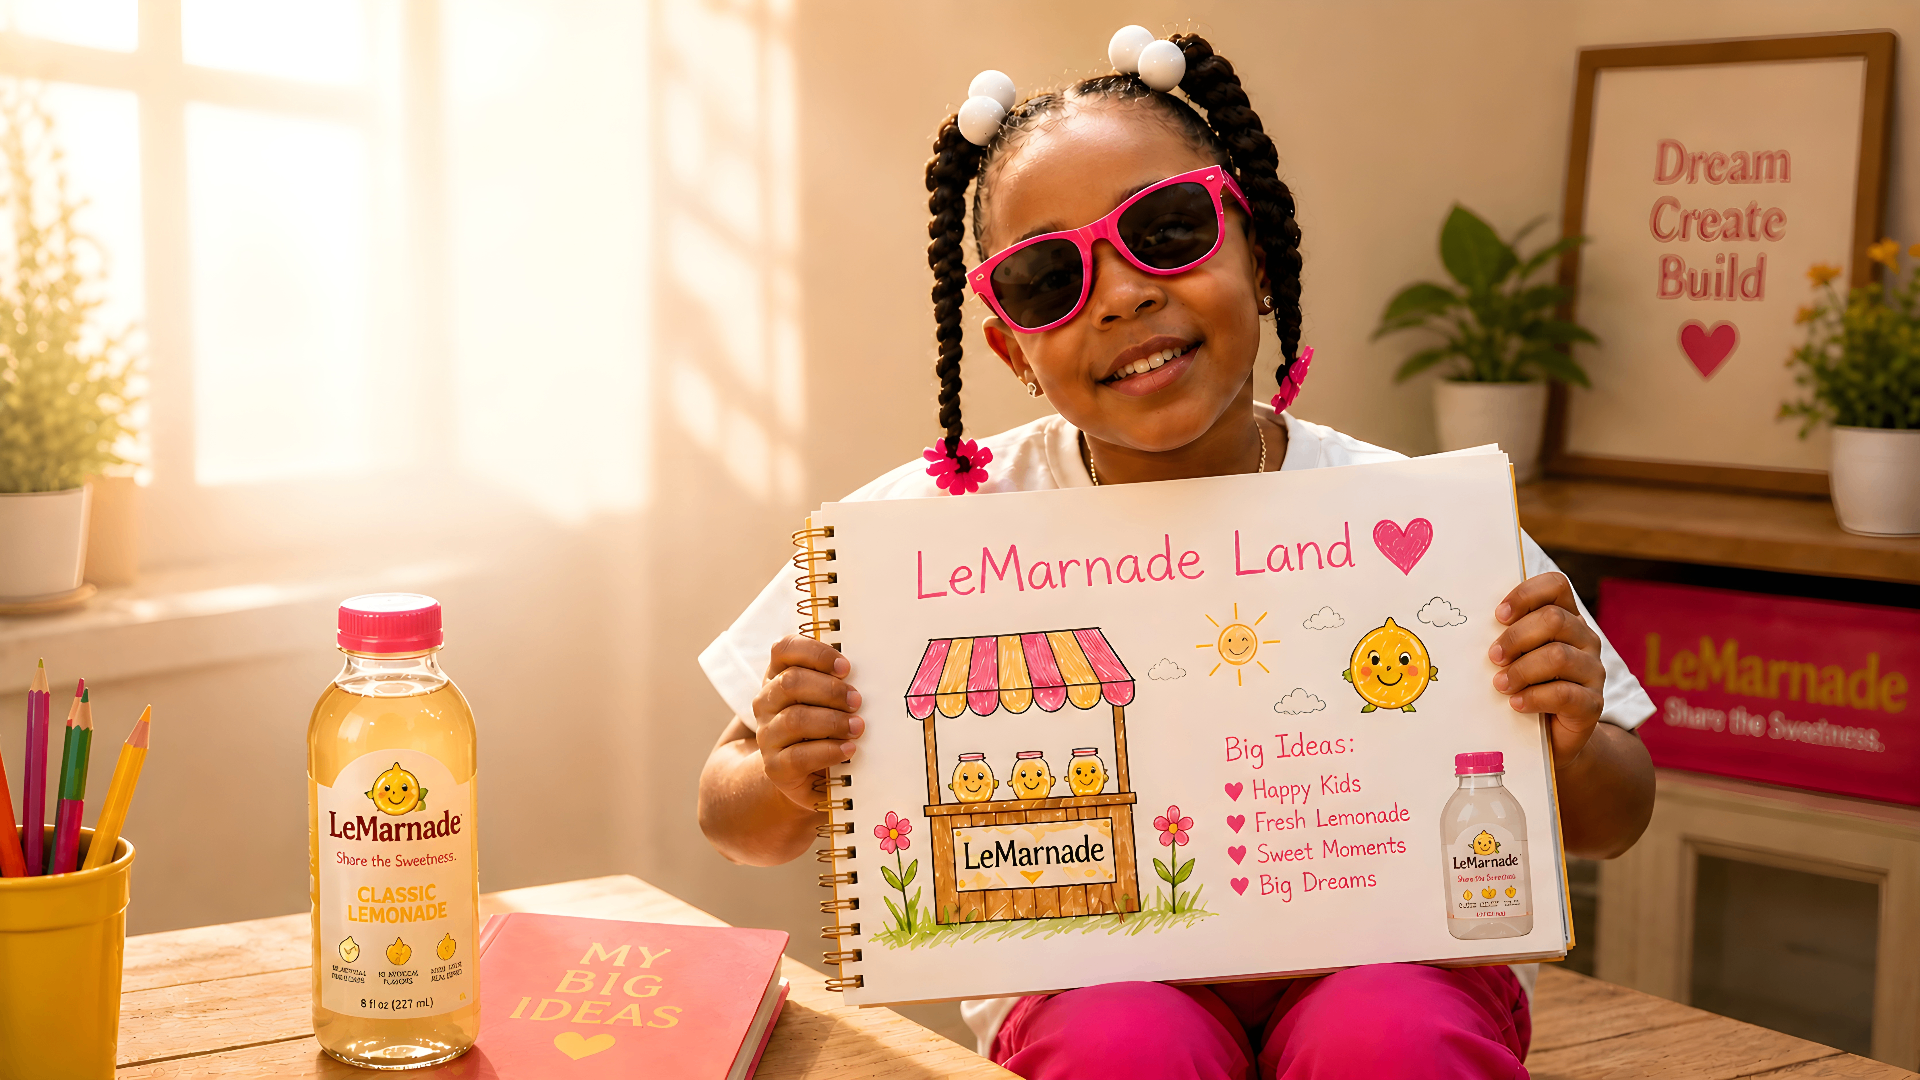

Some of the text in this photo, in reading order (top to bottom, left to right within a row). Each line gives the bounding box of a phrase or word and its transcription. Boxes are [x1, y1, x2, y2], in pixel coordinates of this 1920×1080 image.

[1653, 138, 1792, 185] Dream
[1649, 195, 1787, 243] Create
[1656, 252, 1767, 301] Build
[917, 521, 1355, 599] LeMarnade Land
[1645, 632, 1908, 714] LeMarnade
[1225, 731, 1354, 770] Big Ideas:
[1252, 772, 1362, 805] Happy Kids
[328, 809, 461, 842] LeMarnade
[1255, 801, 1411, 833] Fresh Lemonade
[371, 854, 391, 868] the
[395, 852, 457, 868] Sweetness.
[963, 834, 1105, 870] LeMarnade
[1257, 836, 1407, 863] Sweet Moments
[1452, 853, 1519, 870] LeMarnade
[357, 883, 437, 904] CLASSIC
[1259, 871, 1377, 903] Big Dreams
[347, 901, 448, 924] LEMONADE
[579, 942, 672, 969] MY
[554, 969, 663, 998] BIG
[360, 997, 434, 1012] 8 fl oz (227 mL)
[508, 996, 683, 1029] IDEAS
